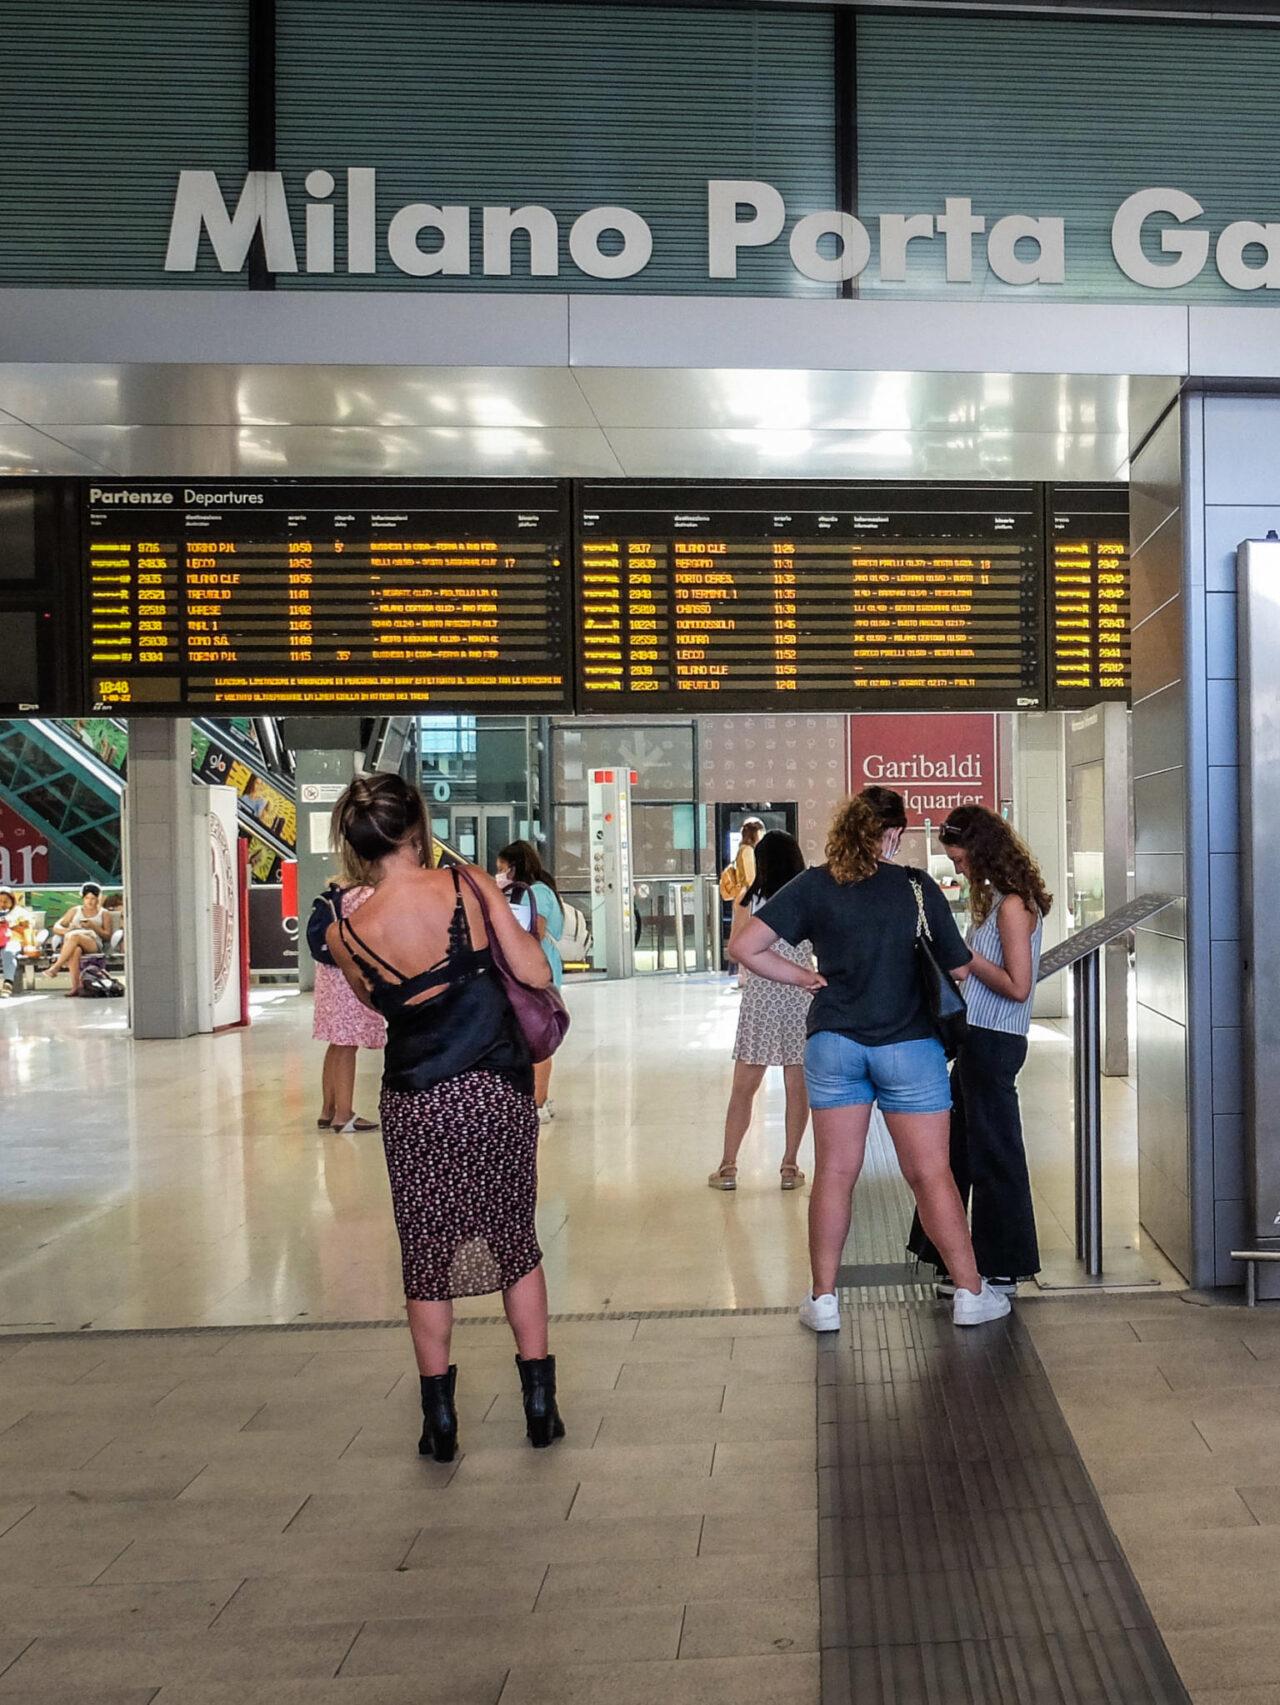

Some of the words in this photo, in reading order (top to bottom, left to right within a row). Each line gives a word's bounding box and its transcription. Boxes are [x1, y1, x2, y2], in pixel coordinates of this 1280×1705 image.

[164, 167, 653, 279] Milano
[708, 179, 1065, 286] Porta
[90, 488, 174, 504] Partenze
[184, 489, 264, 507] Departures
[186, 543, 217, 553] TORINO
[674, 544, 705, 553] MILANO
[186, 559, 216, 568] LECCO
[675, 559, 713, 568] BERGAMO
[774, 559, 792, 569] 11:31
[186, 574, 218, 584] MILANO
[676, 574, 702, 584] PORTO
[774, 574, 794, 584] 11:32
[188, 590, 231, 600] TREVIGLIO
[188, 605, 222, 615] VARESE
[676, 620, 734, 629] DOMODOSSOLA
[188, 636, 210, 646] COMO
[676, 635, 710, 644] NOVARA
[677, 650, 705, 660] LECCO
[677, 665, 708, 675] MILANO
[678, 681, 720, 690] TREVIGLIO
[863, 754, 982, 779] Garibaldi
